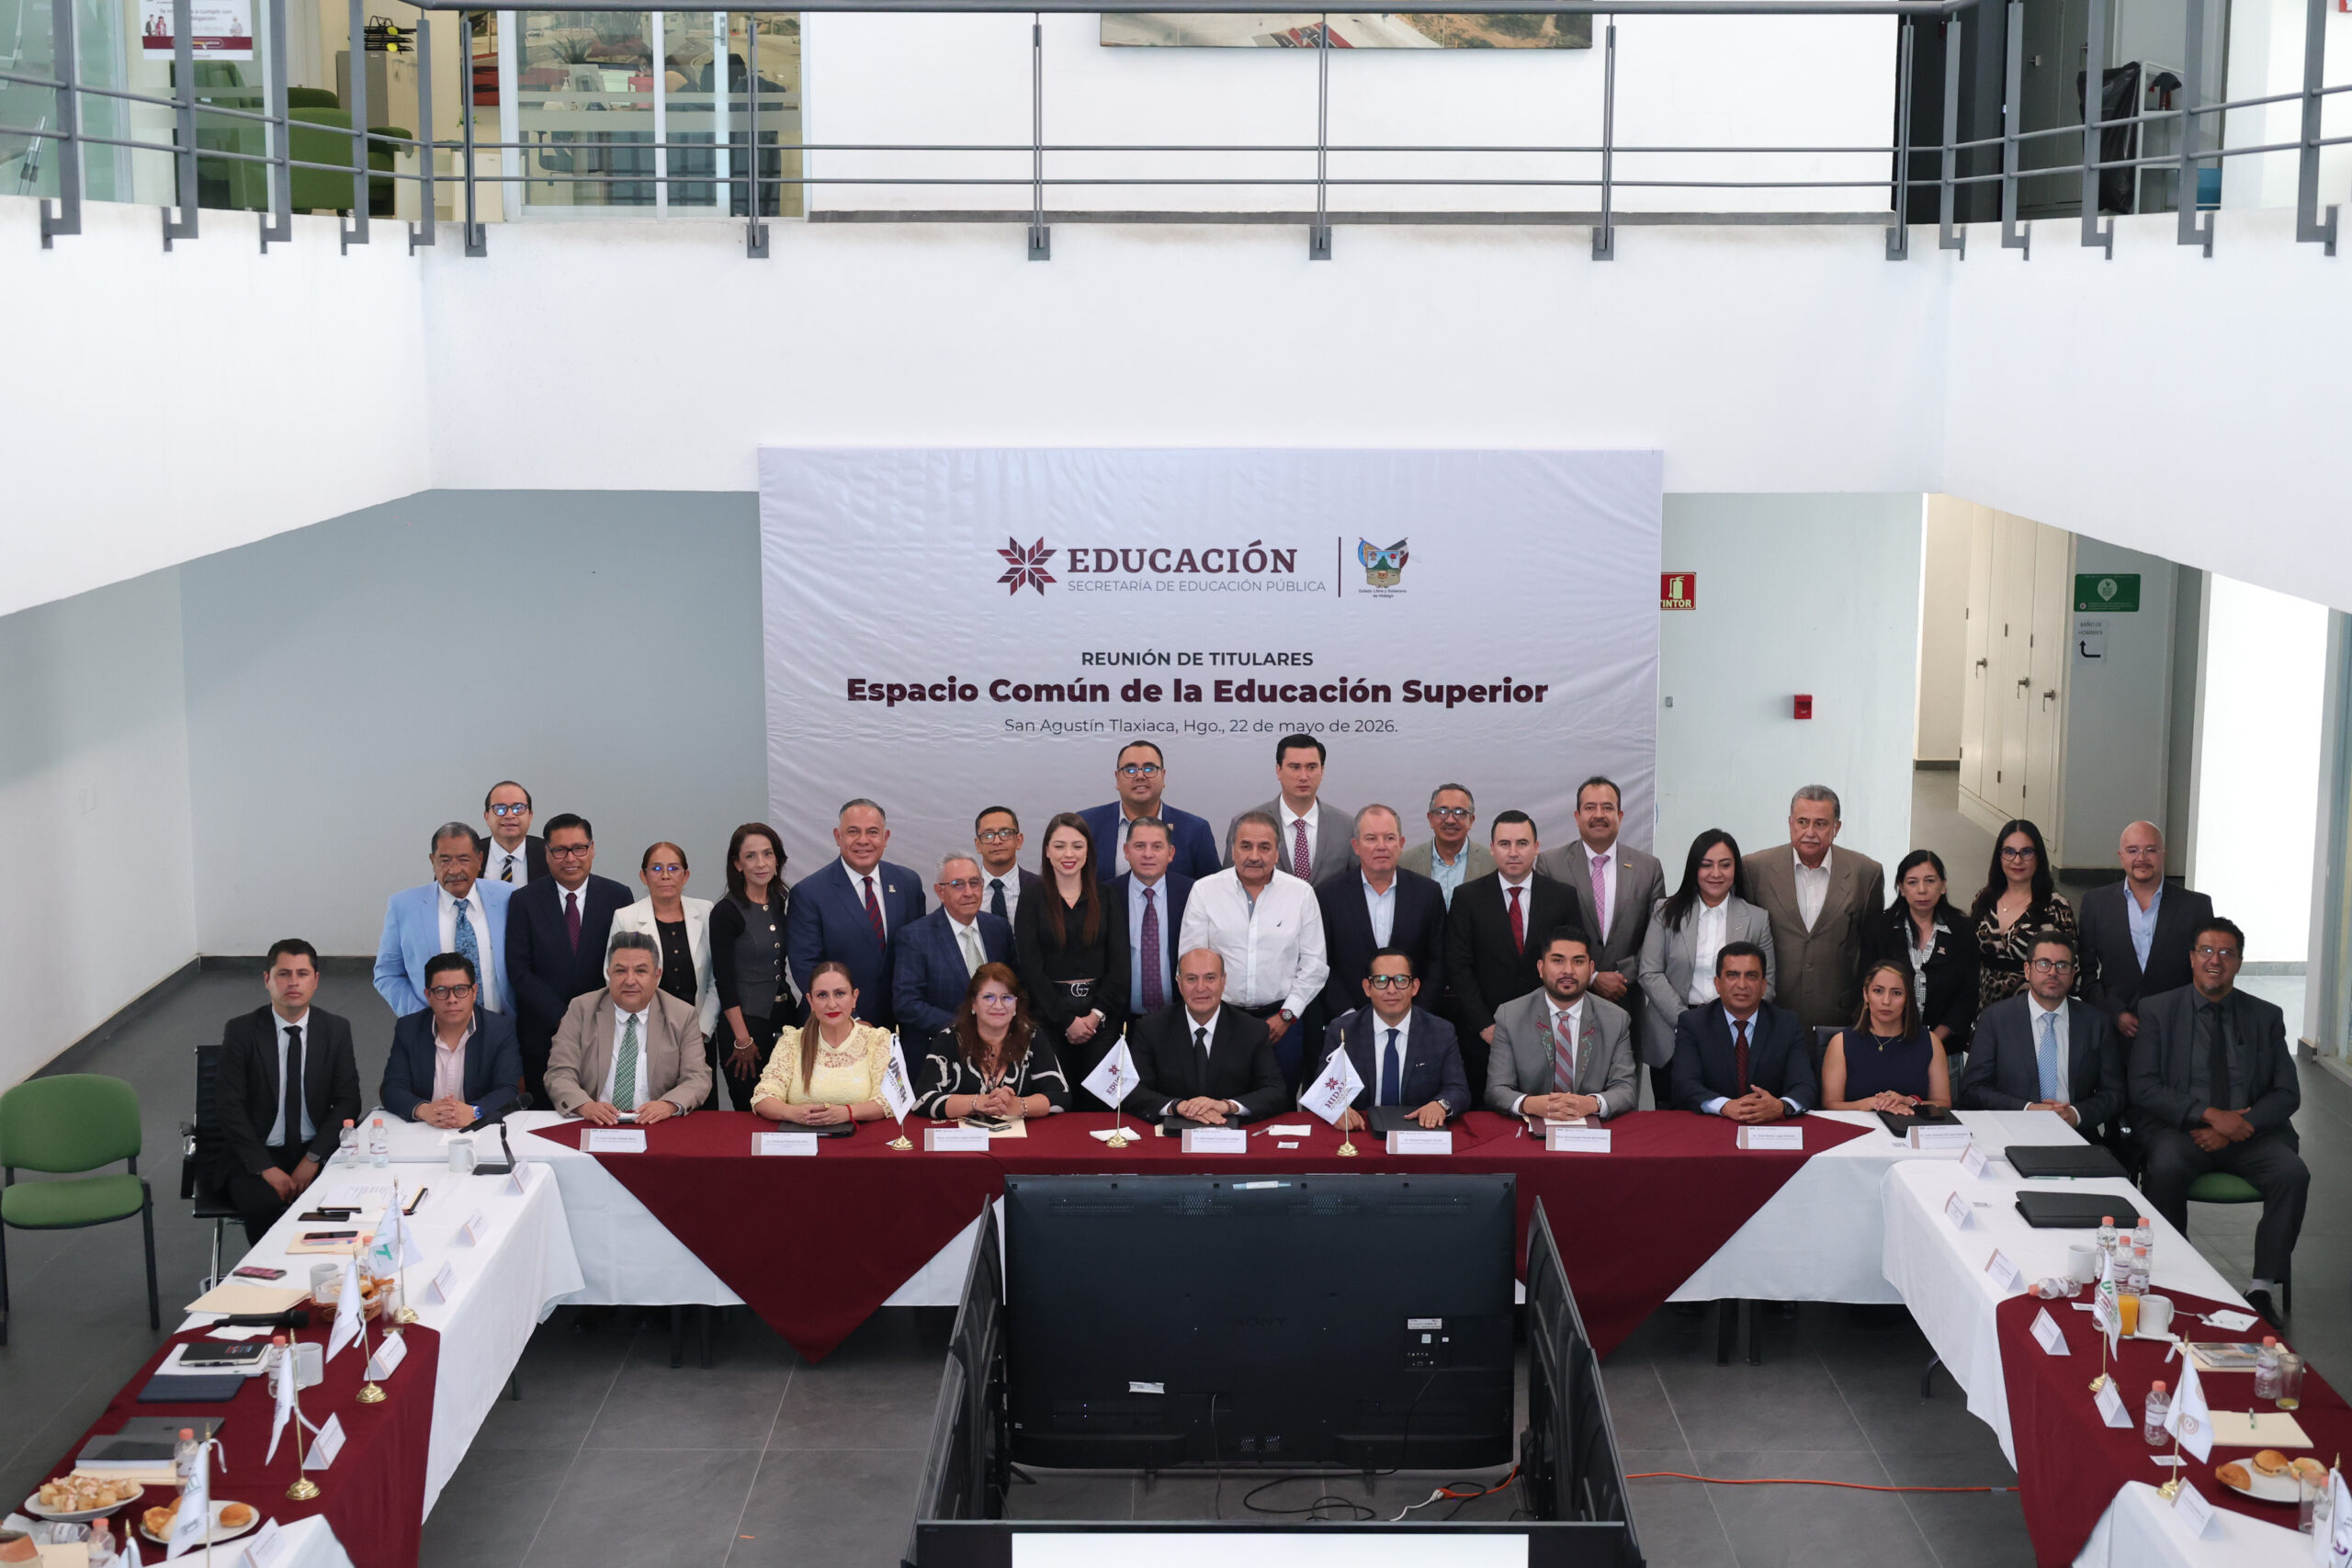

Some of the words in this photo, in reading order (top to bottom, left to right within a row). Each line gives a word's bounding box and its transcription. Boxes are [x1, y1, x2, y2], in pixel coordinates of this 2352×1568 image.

[1068, 539, 1297, 573] EDUCACIÓN
[1068, 578, 1152, 592] SECRETARÍA
[1156, 581, 1175, 592] DE
[1179, 578, 1261, 592] EDUCACIÓN
[1266, 578, 1326, 592] PÚBLICA
[1661, 599, 1692, 608] INTOR
[1082, 649, 1170, 666] REUNIÓN
[1177, 652, 1204, 666] DE
[1208, 652, 1313, 666] TITULARES
[848, 675, 978, 707] Espacio
[989, 677, 1109, 703] Común
[1121, 677, 1162, 703] de
[1174, 677, 1202, 703] la
[1215, 676, 1391, 703] Educación
[1402, 676, 1548, 708] Superior
[1004, 719, 1035, 732] San
[1040, 719, 1103, 734] Agustín
[1109, 719, 1179, 734] Tlaxiaca,
[1184, 719, 1225, 735] Hgo.,
[1229, 719, 1248, 732] 22
[1252, 719, 1273, 732] de
[1279, 722, 1324, 735] mayo
[1329, 719, 1350, 732] de
[1354, 719, 1397, 732] 2026.
